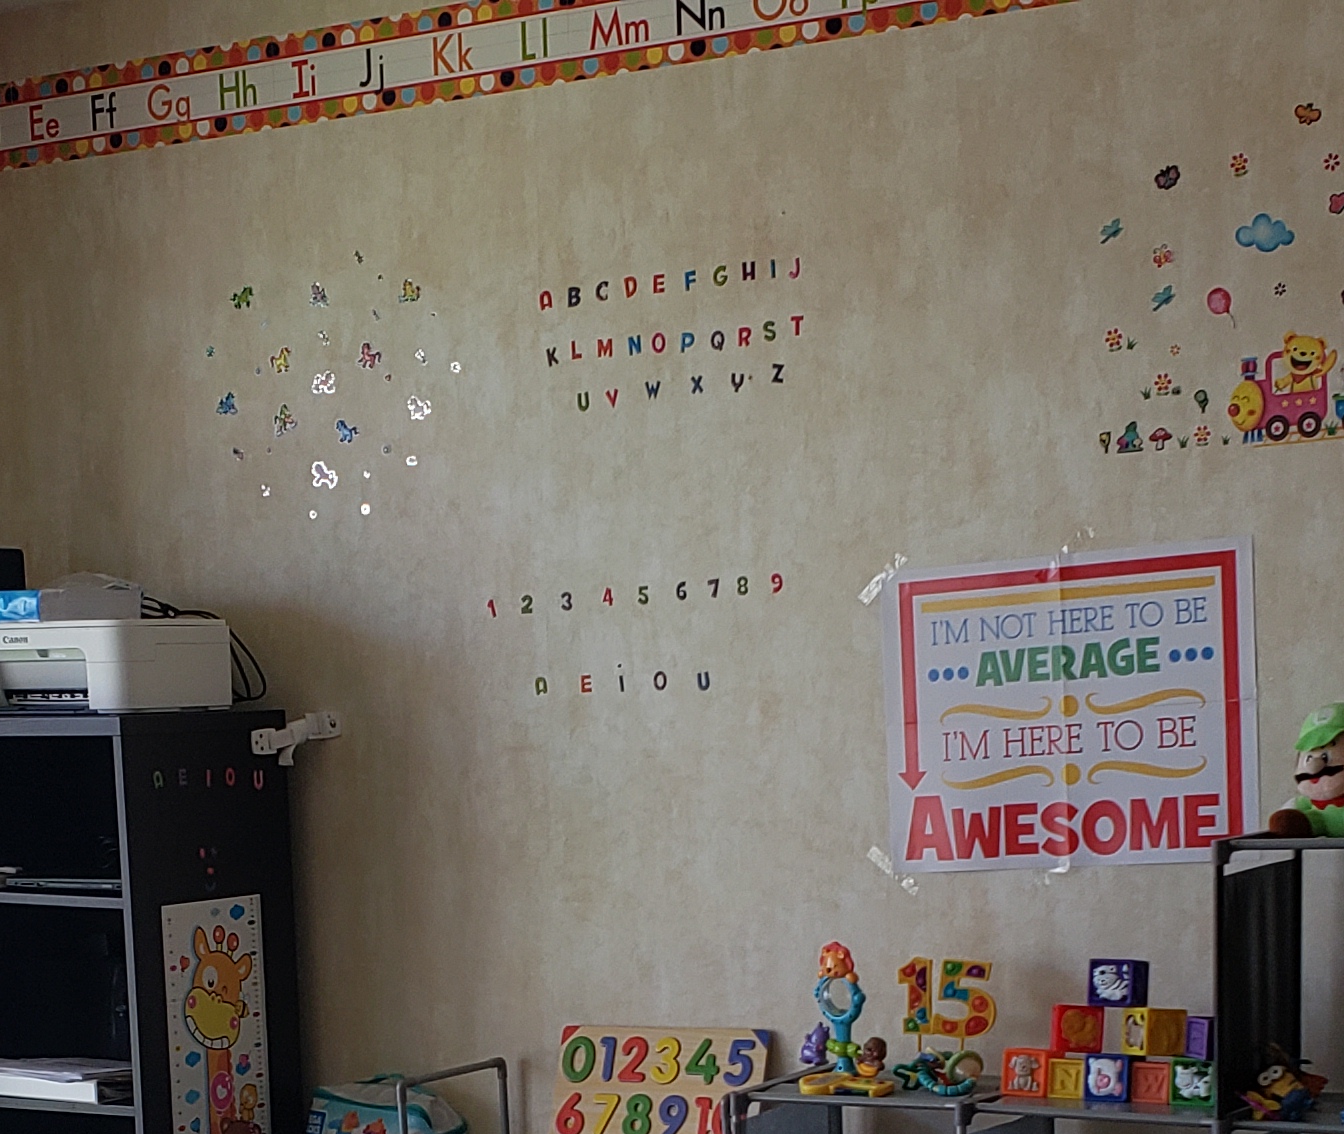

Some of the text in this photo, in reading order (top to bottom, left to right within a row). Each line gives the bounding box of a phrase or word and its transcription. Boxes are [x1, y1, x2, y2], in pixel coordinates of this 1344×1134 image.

[29, 105, 60, 141] Ee
[91, 94, 116, 131] Ff
[147, 84, 190, 121] Gg
[219, 70, 256, 111] Hh
[292, 60, 315, 98] Ii
[359, 49, 384, 94] Jj
[432, 33, 474, 76] Kk
[521, 19, 548, 60] Ll
[590, 12, 649, 50] Mm
[676, 0, 725, 36] Nn
[539, 257, 801, 311] A B C D E F G H I J
[546, 315, 804, 367] K L M N O P Q R S T
[577, 363, 785, 412] U V W X Y Z
[487, 573, 783, 618] 1 2 3 4 5 6 7 8 9
[2, 635, 29, 644] Canon
[930, 597, 1208, 645] I'M NOT HERE TO BE
[534, 677, 548, 695] A
[580, 674, 592, 693] E
[653, 671, 667, 691] O
[697, 671, 710, 691] U
[975, 637, 1161, 687] AVERAGE
[942, 716, 1197, 762] I'M HERE TO BE
[152, 770, 164, 789] A
[178, 769, 187, 785] E
[224, 767, 235, 787] O
[252, 769, 265, 791] U
[905, 794, 1221, 861] AWESOME
[898, 956, 996, 1037] 15
